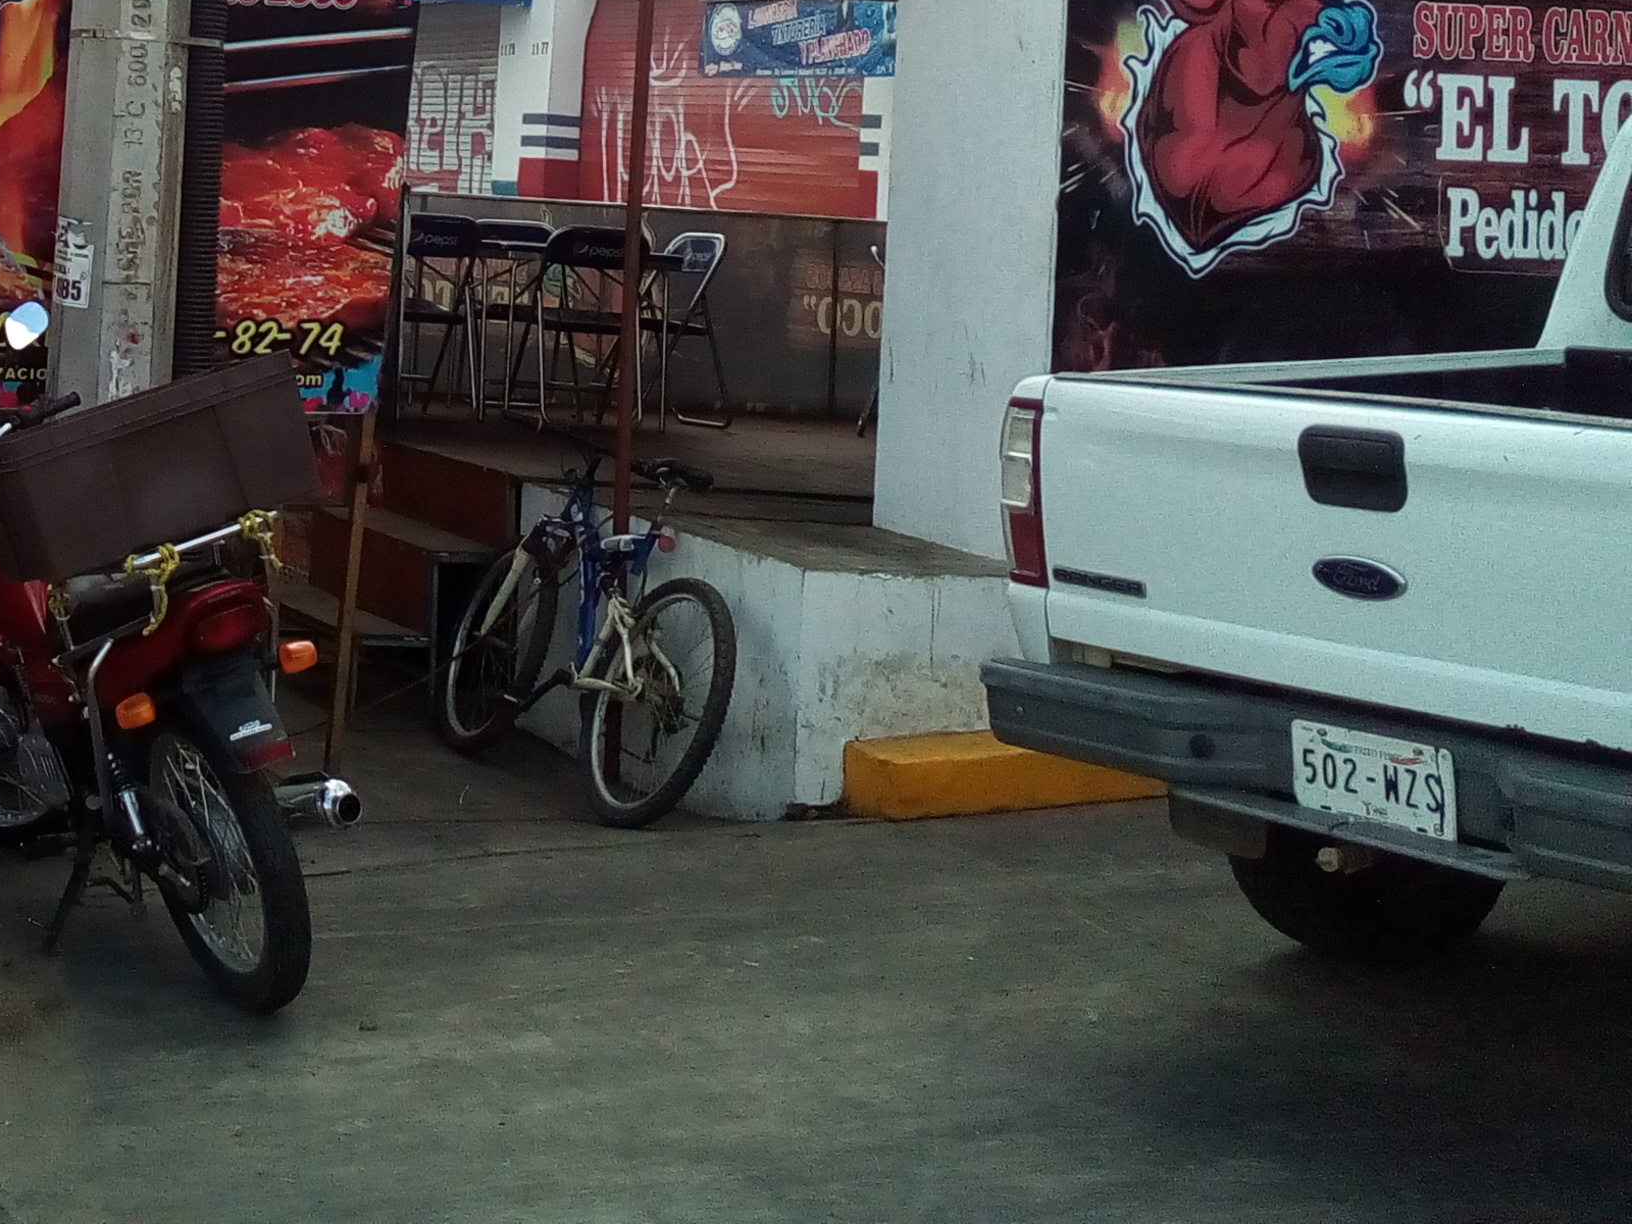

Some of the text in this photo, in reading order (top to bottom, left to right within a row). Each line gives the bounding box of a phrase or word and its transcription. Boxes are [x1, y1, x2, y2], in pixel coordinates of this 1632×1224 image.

[1413, 1, 1534, 63] SUPER
[1403, 70, 1529, 164] “EL
[424, 234, 459, 247] pepsi
